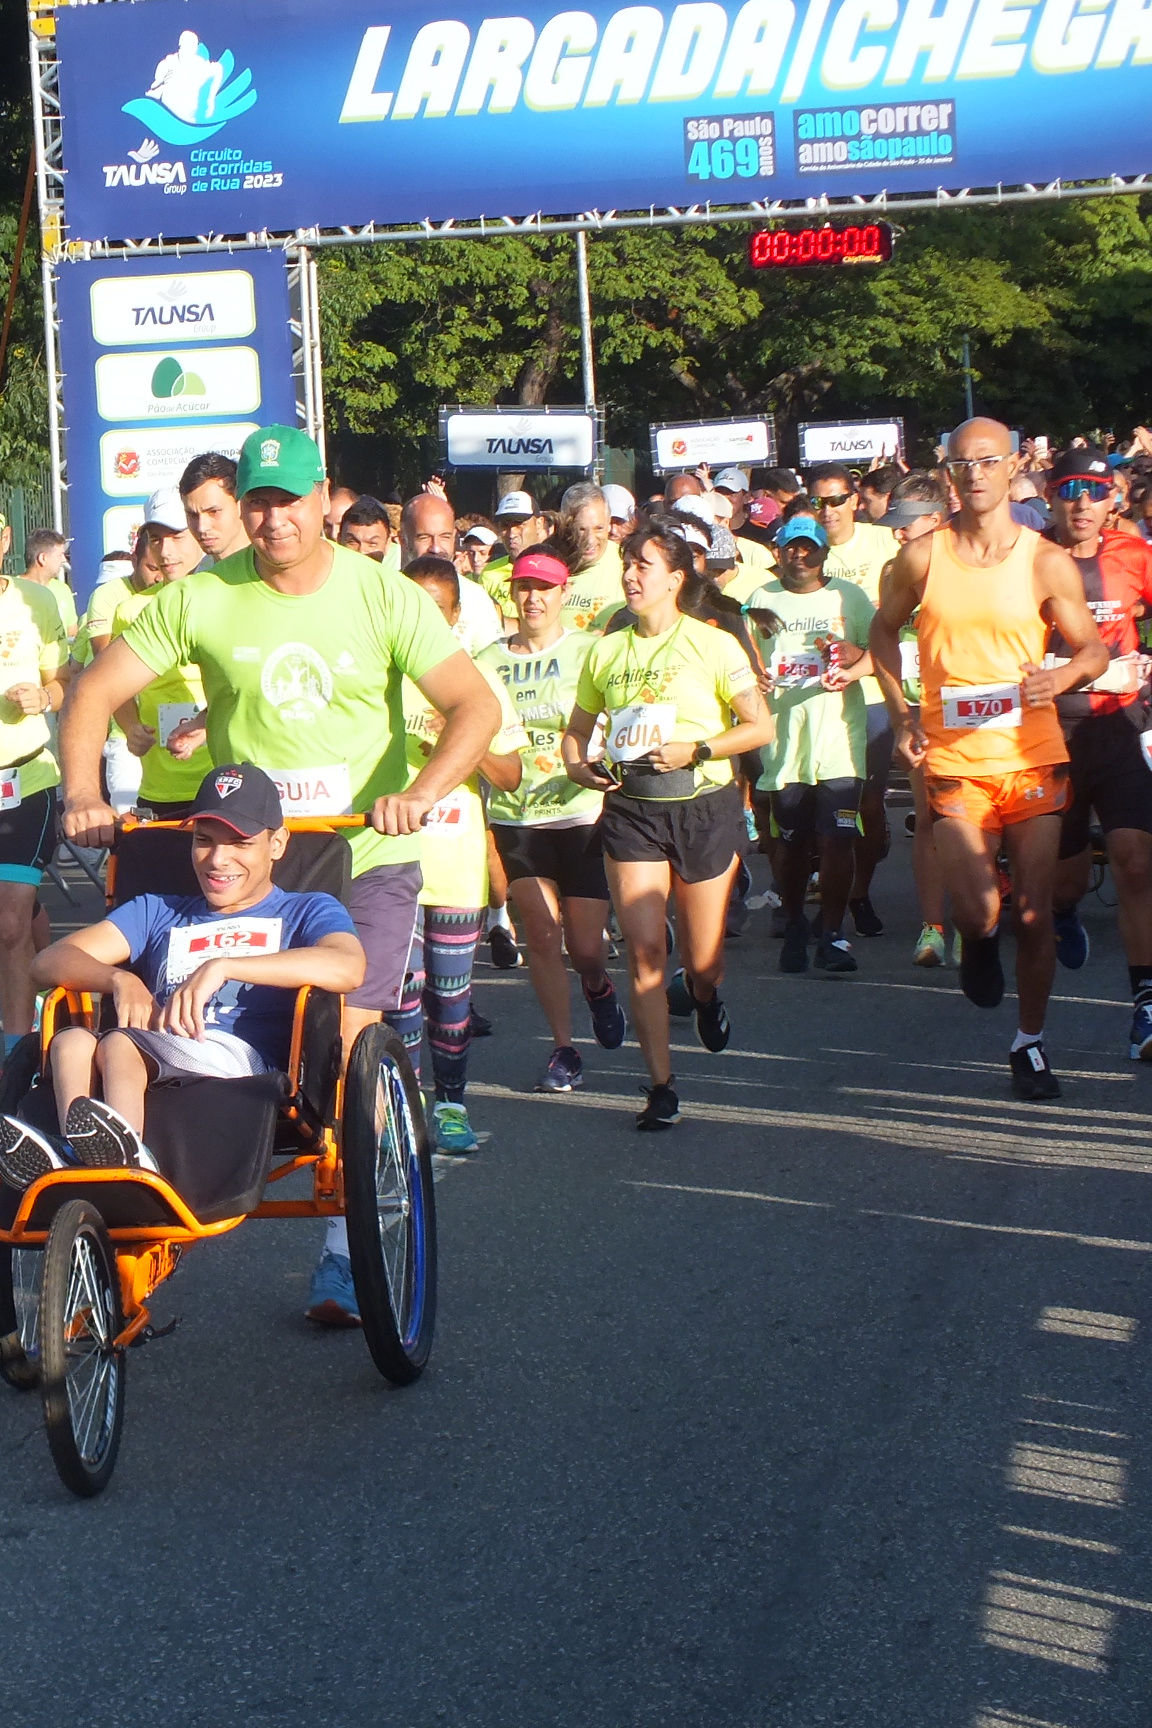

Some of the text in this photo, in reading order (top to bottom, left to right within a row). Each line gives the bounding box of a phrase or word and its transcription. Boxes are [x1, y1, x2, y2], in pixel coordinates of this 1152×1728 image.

[686, 116, 772, 141] São Paulo
[798, 103, 952, 139] amocorrer
[190, 148, 242, 162] Circuito
[758, 136, 773, 177] anos
[798, 131, 953, 165] amosãopaulo
[191, 160, 273, 177] de Corridas
[688, 138, 759, 180] 469
[163, 184, 187, 195] Group
[192, 173, 283, 192] de Rua 2023
[753, 226, 879, 261] 00:00:00
[147, 446, 195, 456] ASSOCIAÇÃO
[496, 658, 560, 686] GUIA
[606, 668, 659, 689] Achilles
[516, 689, 536, 702] em
[968, 699, 1002, 716] 170
[614, 724, 662, 749] GUIA
[274, 780, 331, 801] GUIA
[204, 930, 252, 950] 162
